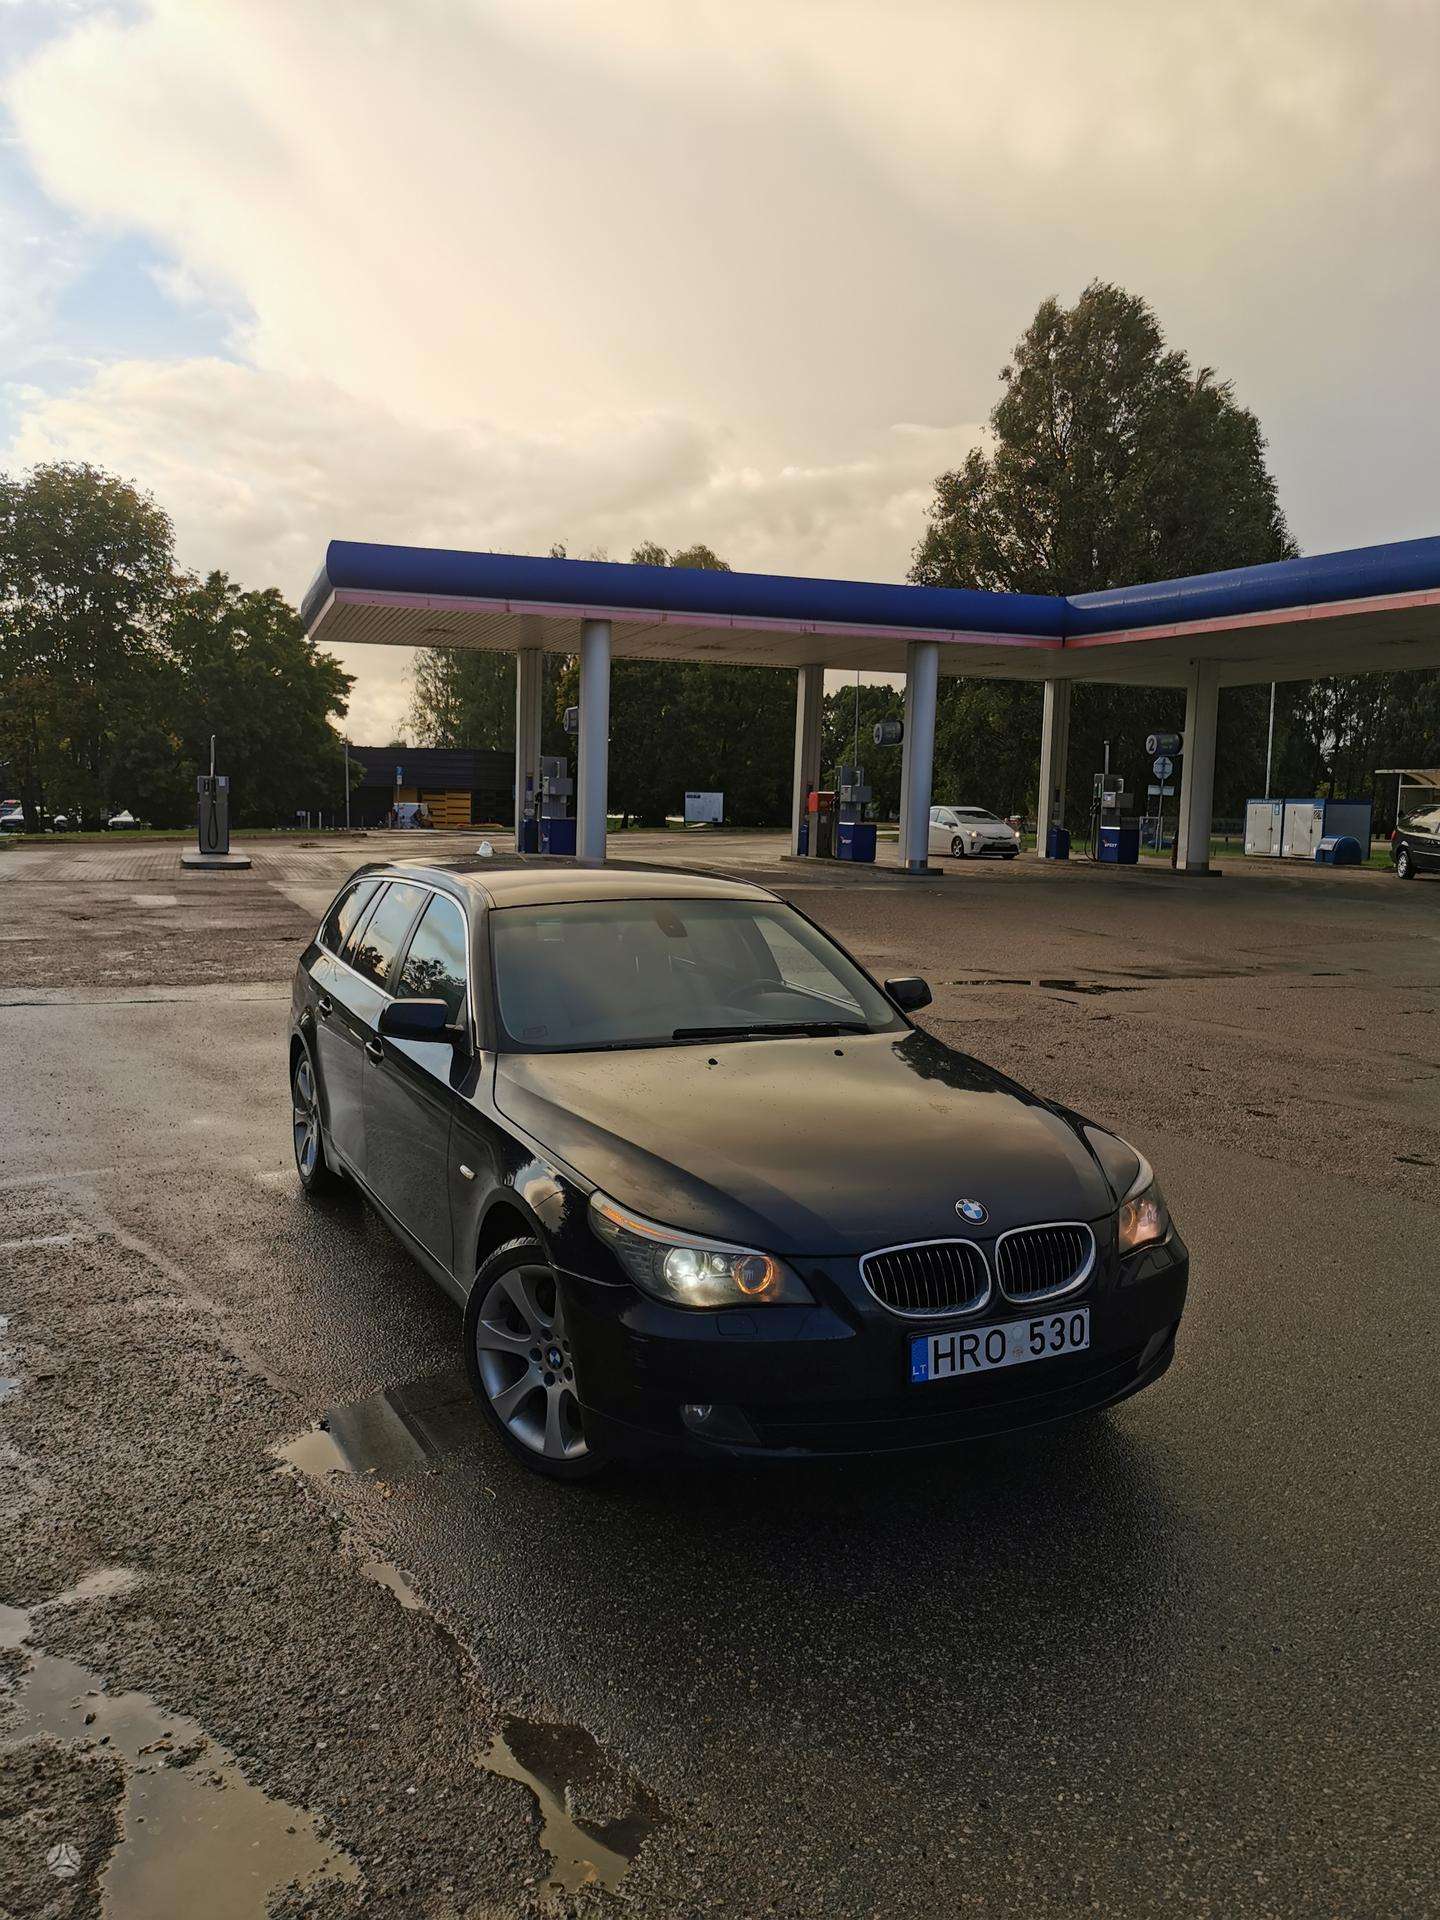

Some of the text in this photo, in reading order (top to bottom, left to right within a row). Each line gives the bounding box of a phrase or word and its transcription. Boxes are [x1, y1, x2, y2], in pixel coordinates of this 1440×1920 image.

[933, 1314, 1085, 1375] HRO 530
[912, 1364, 928, 1376] LT
